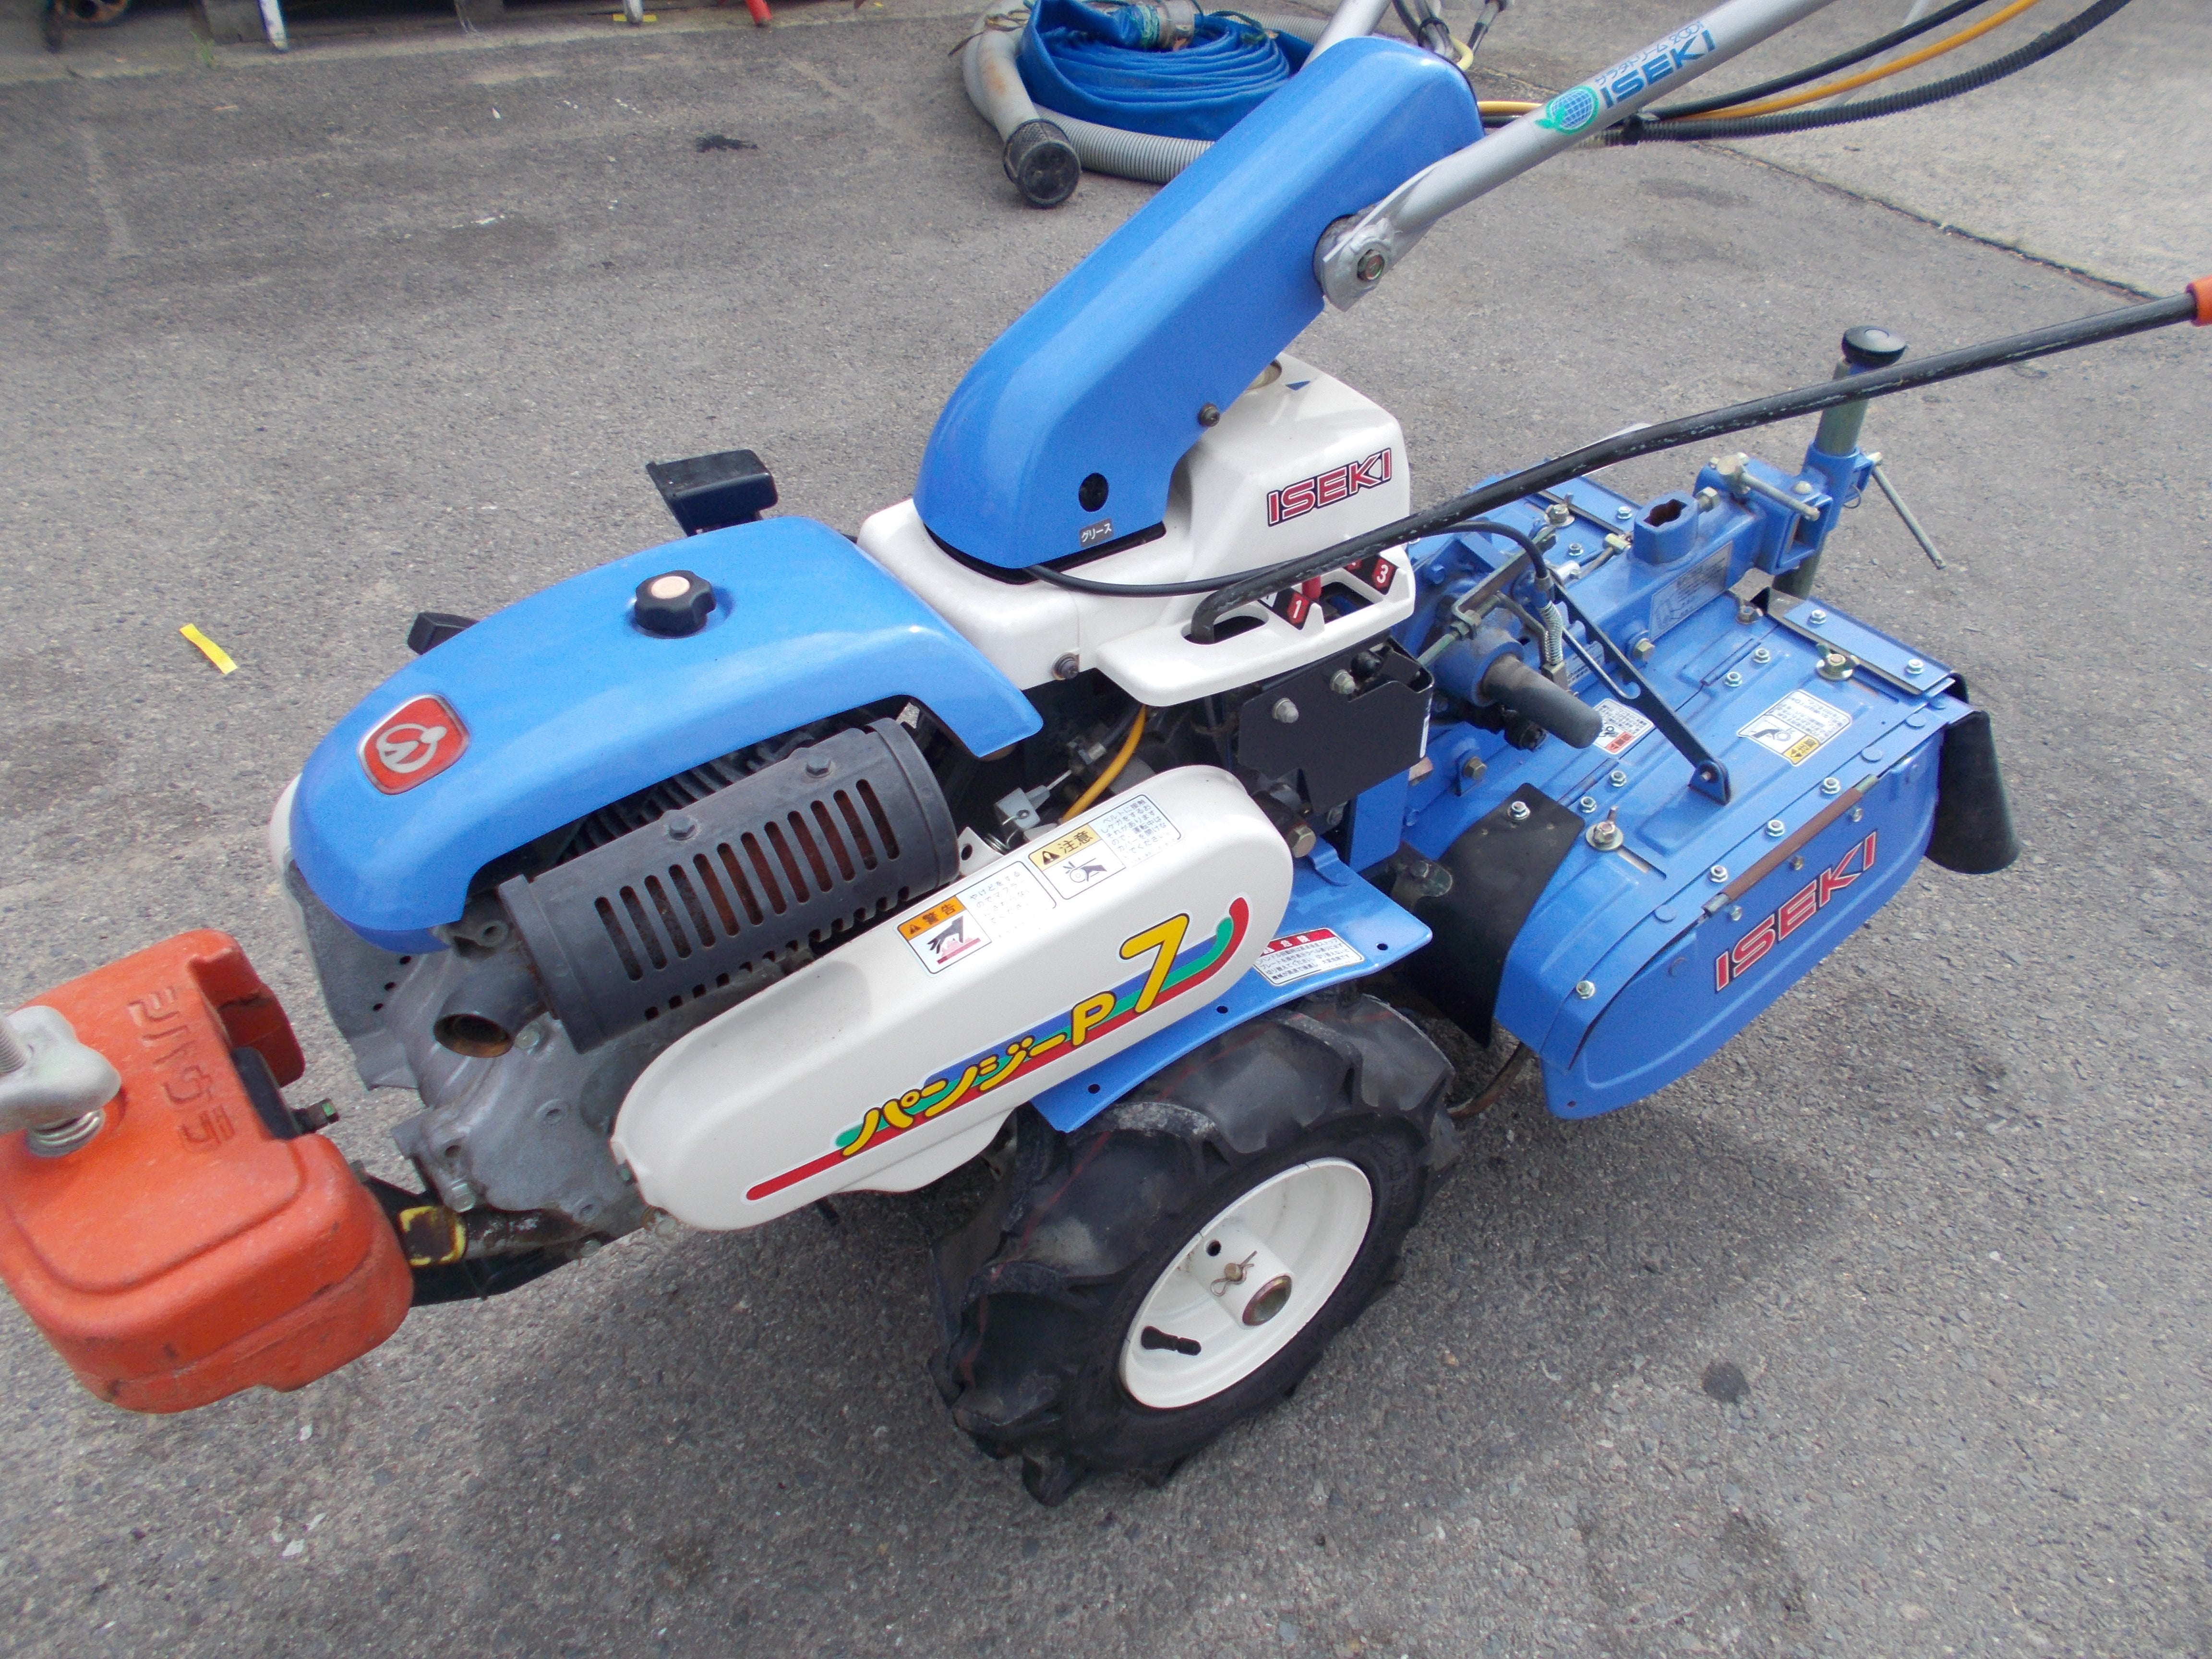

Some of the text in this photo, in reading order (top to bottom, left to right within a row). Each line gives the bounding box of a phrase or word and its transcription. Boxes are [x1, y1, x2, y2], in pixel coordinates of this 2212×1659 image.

[1670, 21, 1704, 45] 2001
[1599, 29, 1715, 108] ISEKI
[1268, 448, 1391, 526] ISEKI
[1081, 523, 1112, 542] グリース
[1376, 565, 1389, 583] 3
[1292, 600, 1302, 619] 1
[1100, 804, 1152, 833] しケガをするお
[1102, 798, 1146, 824] ベルトに接触
[1106, 810, 1156, 839] それがあります
[1057, 829, 1094, 854] 注意
[1110, 815, 1162, 845] ので、運転中は
[1116, 821, 1167, 851] カバーを開けな
[969, 870, 1021, 901] やけどをする
[975, 878, 1026, 908] のでマフラー
[922, 902, 957, 926] 警告
[1715, 831, 1878, 992] ISEKI
[1280, 935, 1310, 948] 危険
